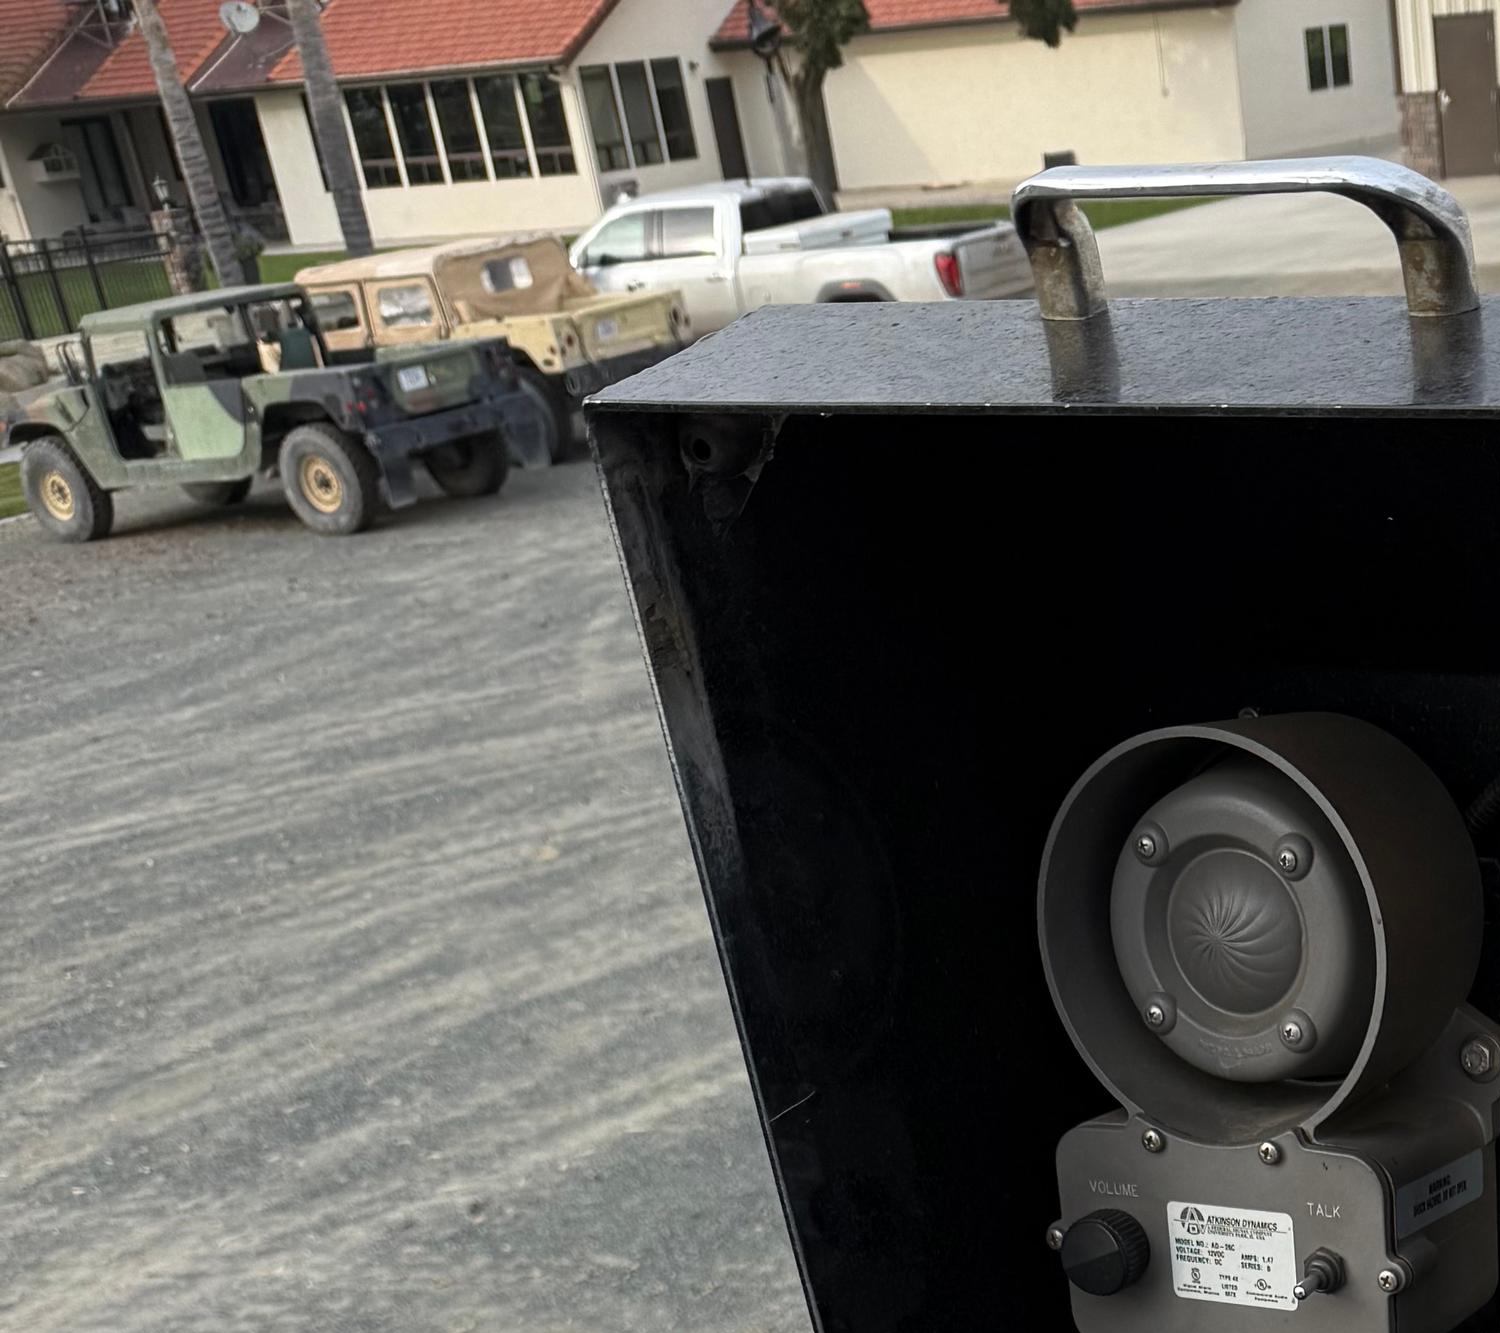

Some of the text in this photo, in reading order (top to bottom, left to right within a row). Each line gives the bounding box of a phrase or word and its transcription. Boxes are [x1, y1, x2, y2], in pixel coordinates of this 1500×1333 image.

[1089, 1180, 1139, 1198] VOLUME
[1307, 1201, 1342, 1219] TALK
[1206, 1215, 1241, 1227] ATKINSON
[1242, 1219, 1278, 1232] DYNAMICS
